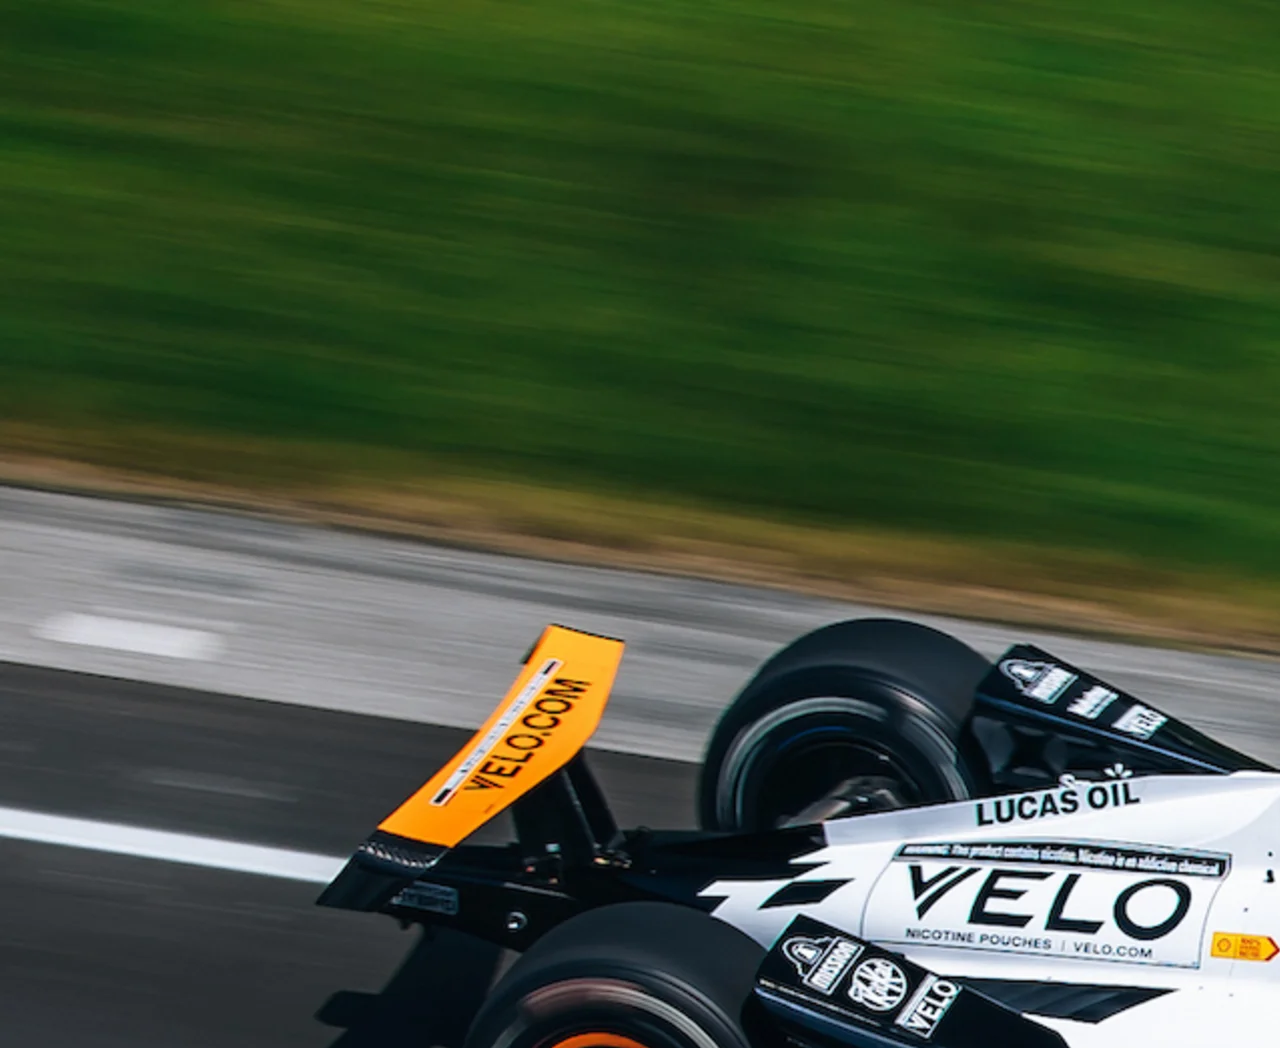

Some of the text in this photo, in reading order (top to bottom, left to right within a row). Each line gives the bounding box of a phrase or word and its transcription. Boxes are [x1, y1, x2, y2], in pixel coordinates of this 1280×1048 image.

[464, 678, 591, 790] VELO.COM
[977, 782, 1140, 826] LUCAS OIL
[908, 865, 1192, 941] VELO
[905, 927, 1153, 958] NICOTINE POUCHES VELO.COM
[904, 980, 958, 1030] VELO
